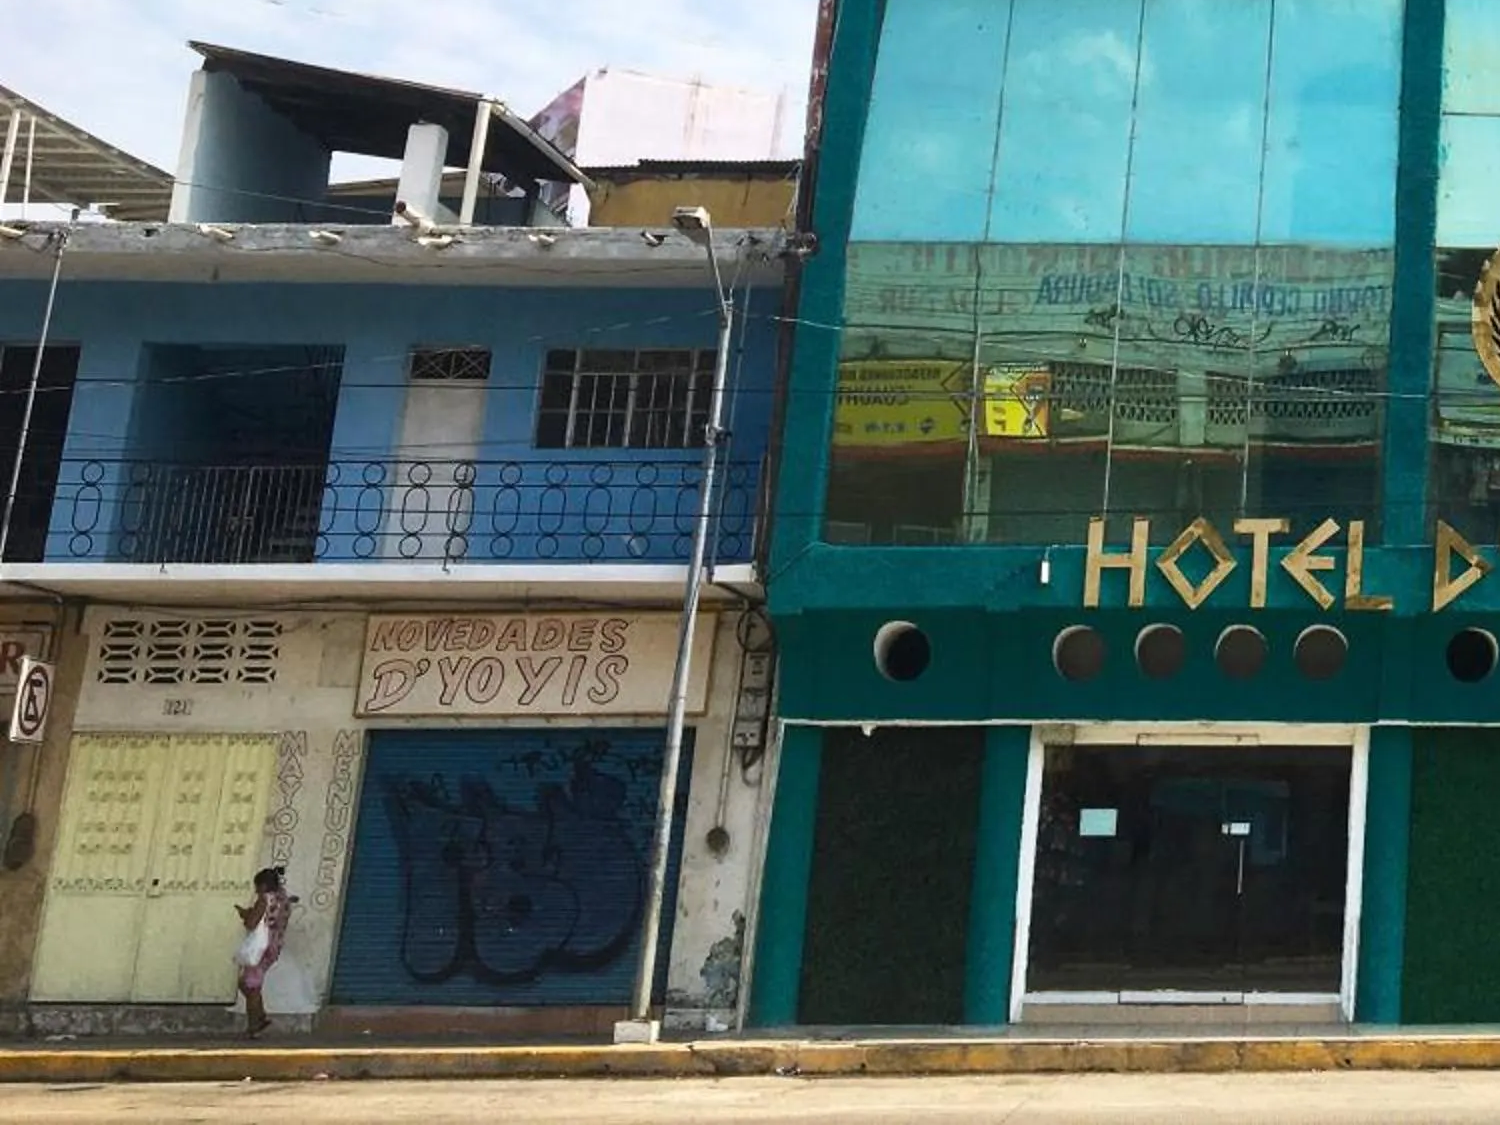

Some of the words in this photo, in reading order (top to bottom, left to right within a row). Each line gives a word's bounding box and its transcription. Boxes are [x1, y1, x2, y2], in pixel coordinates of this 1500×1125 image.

[1083, 516, 1395, 611] HOTEL
[371, 618, 629, 653] NOVEDADES
[271, 730, 308, 885] MAYOR
